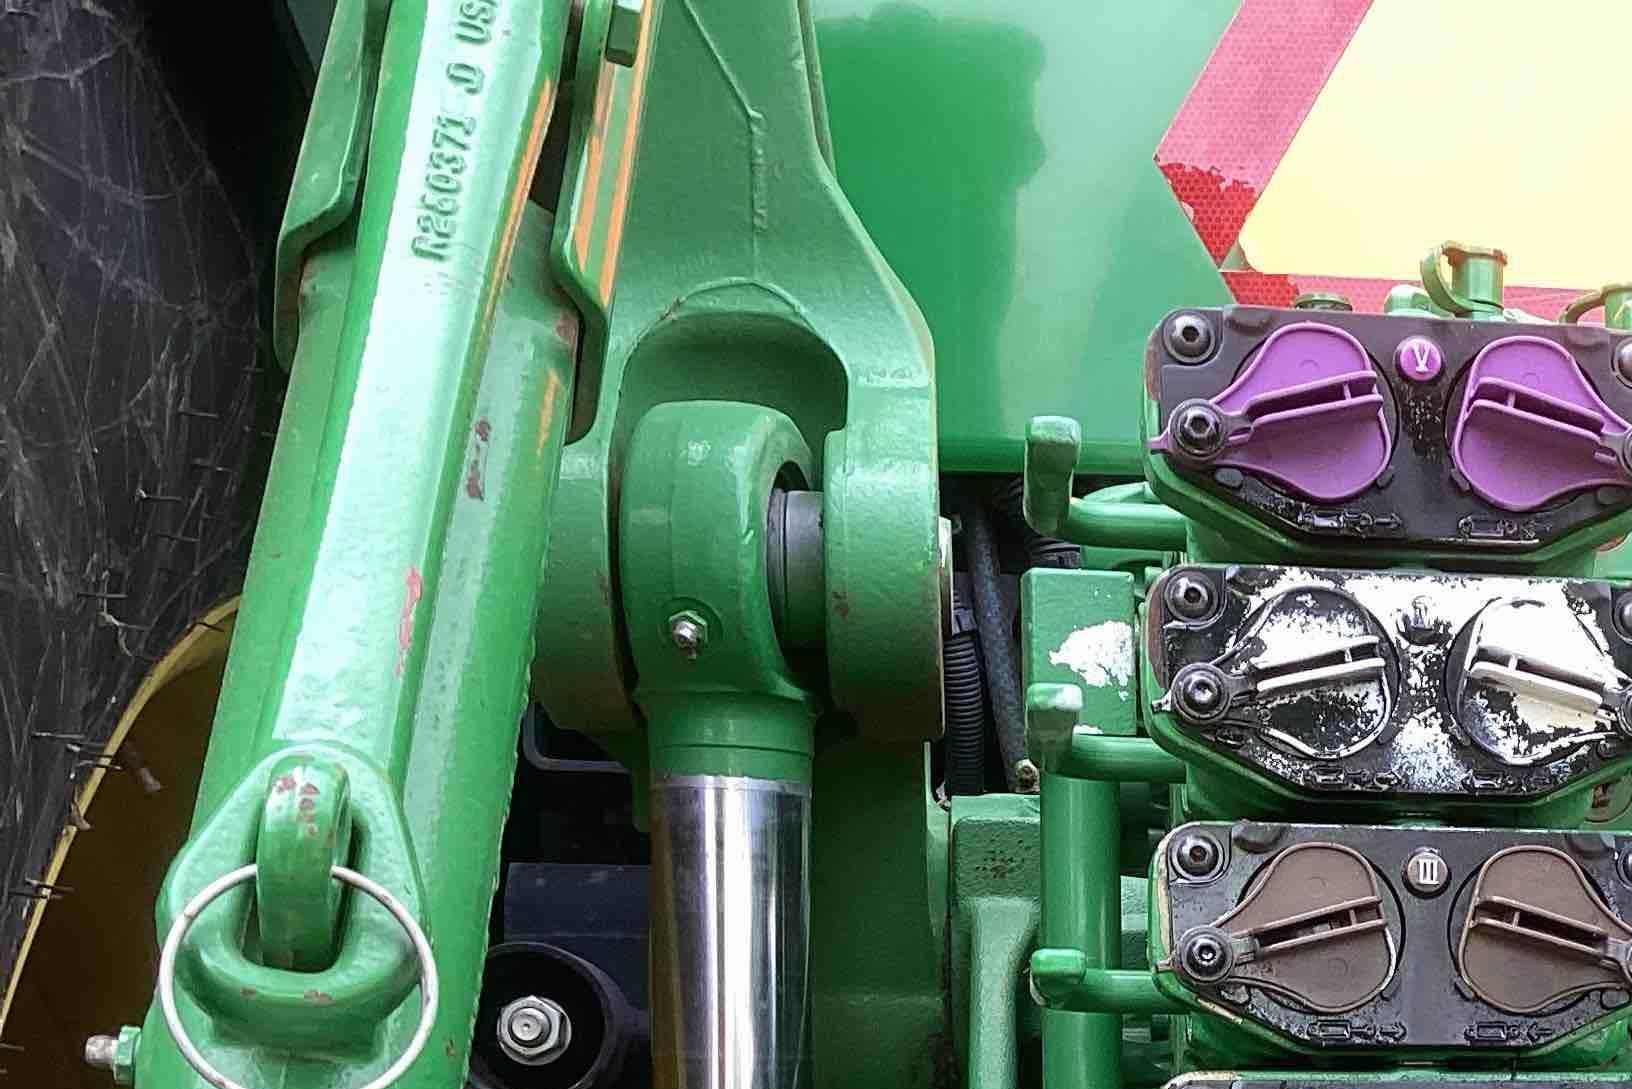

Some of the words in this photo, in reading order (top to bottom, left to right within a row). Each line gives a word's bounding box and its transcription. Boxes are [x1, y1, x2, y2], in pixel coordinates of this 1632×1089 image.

[455, 0, 500, 45] US
[1410, 341, 1432, 372] V
[1418, 858, 1440, 885] III
